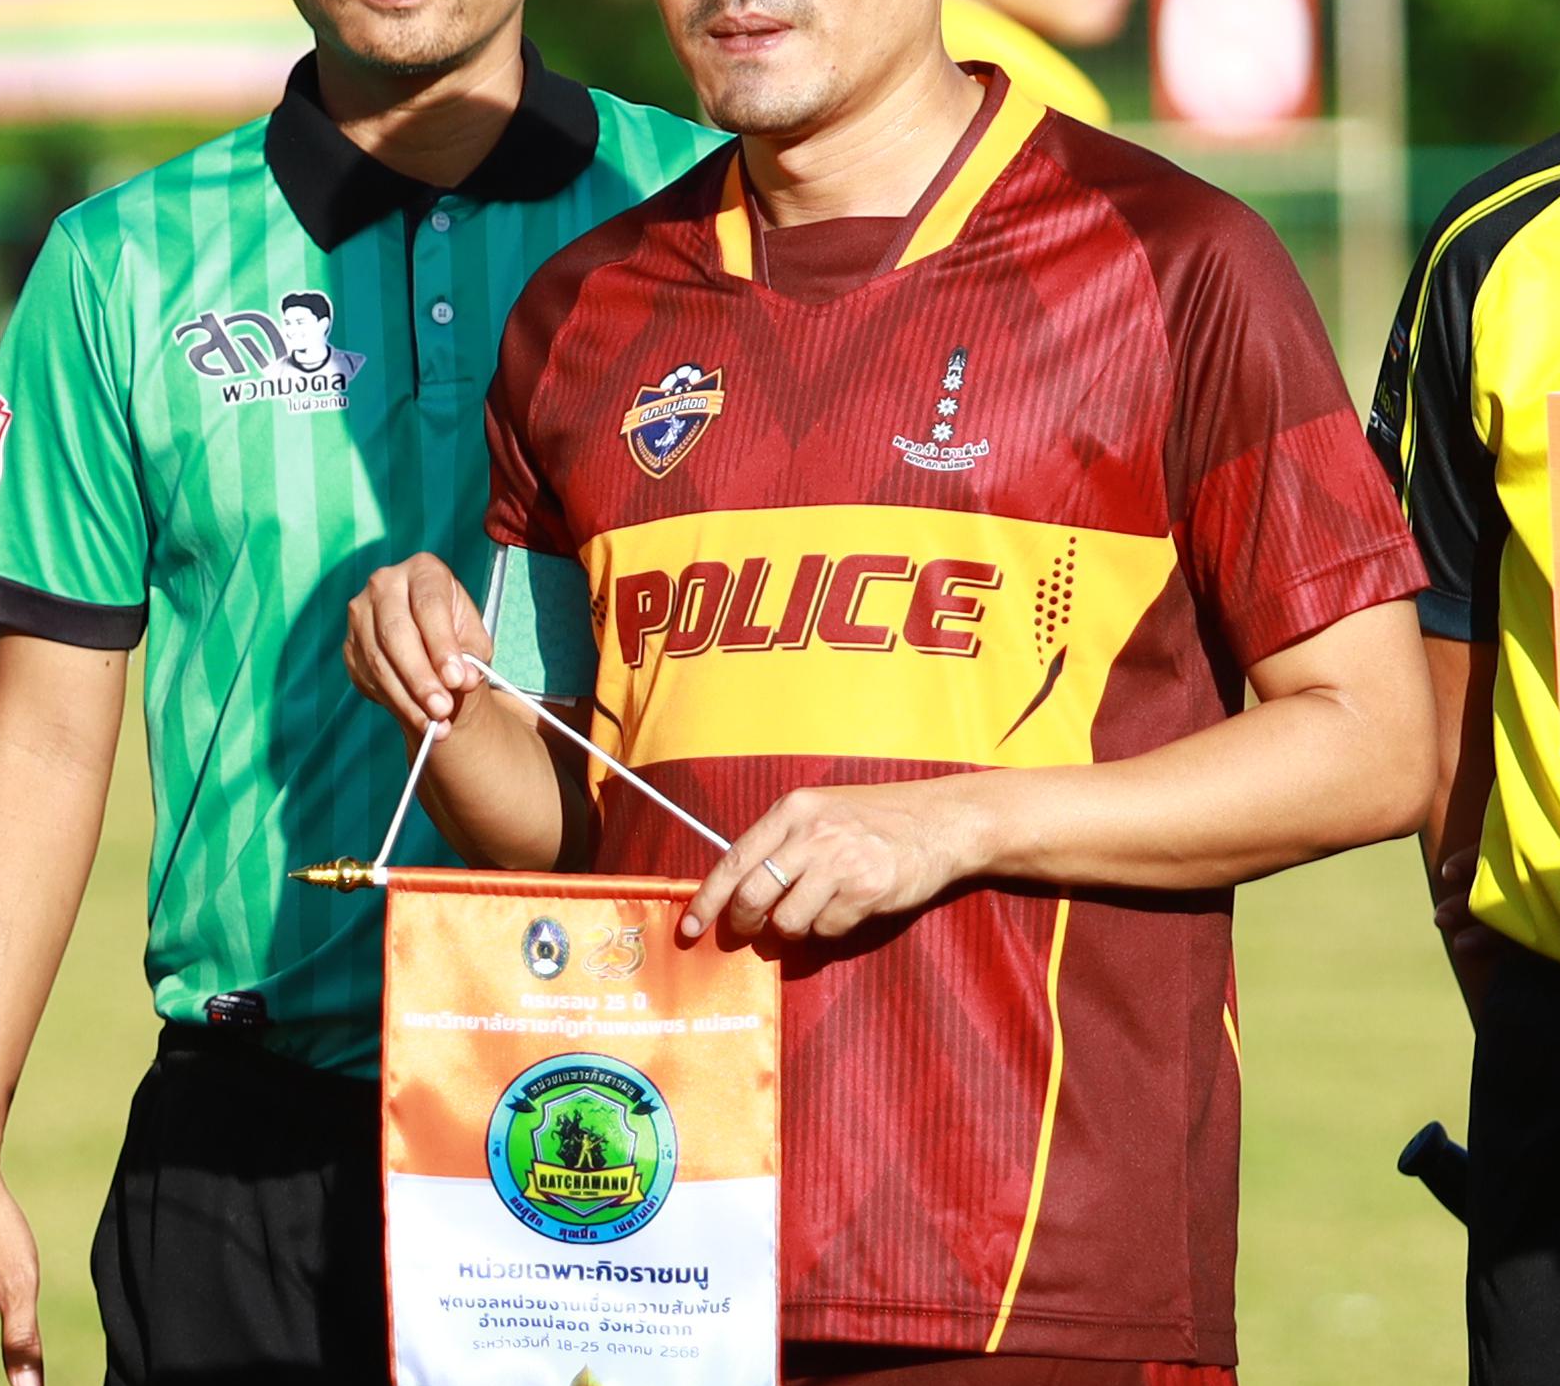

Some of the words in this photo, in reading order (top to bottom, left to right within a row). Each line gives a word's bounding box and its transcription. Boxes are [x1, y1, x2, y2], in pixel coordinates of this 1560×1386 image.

[223, 373, 347, 403] พวกมงคล
[615, 553, 1004, 669] POLICE
[459, 1257, 710, 1290] หน่วยเฉพาะกิจราชมนู
[479, 1312, 590, 1333] อำเภอแม่สอด
[557, 1338, 600, 1353] 18-25
